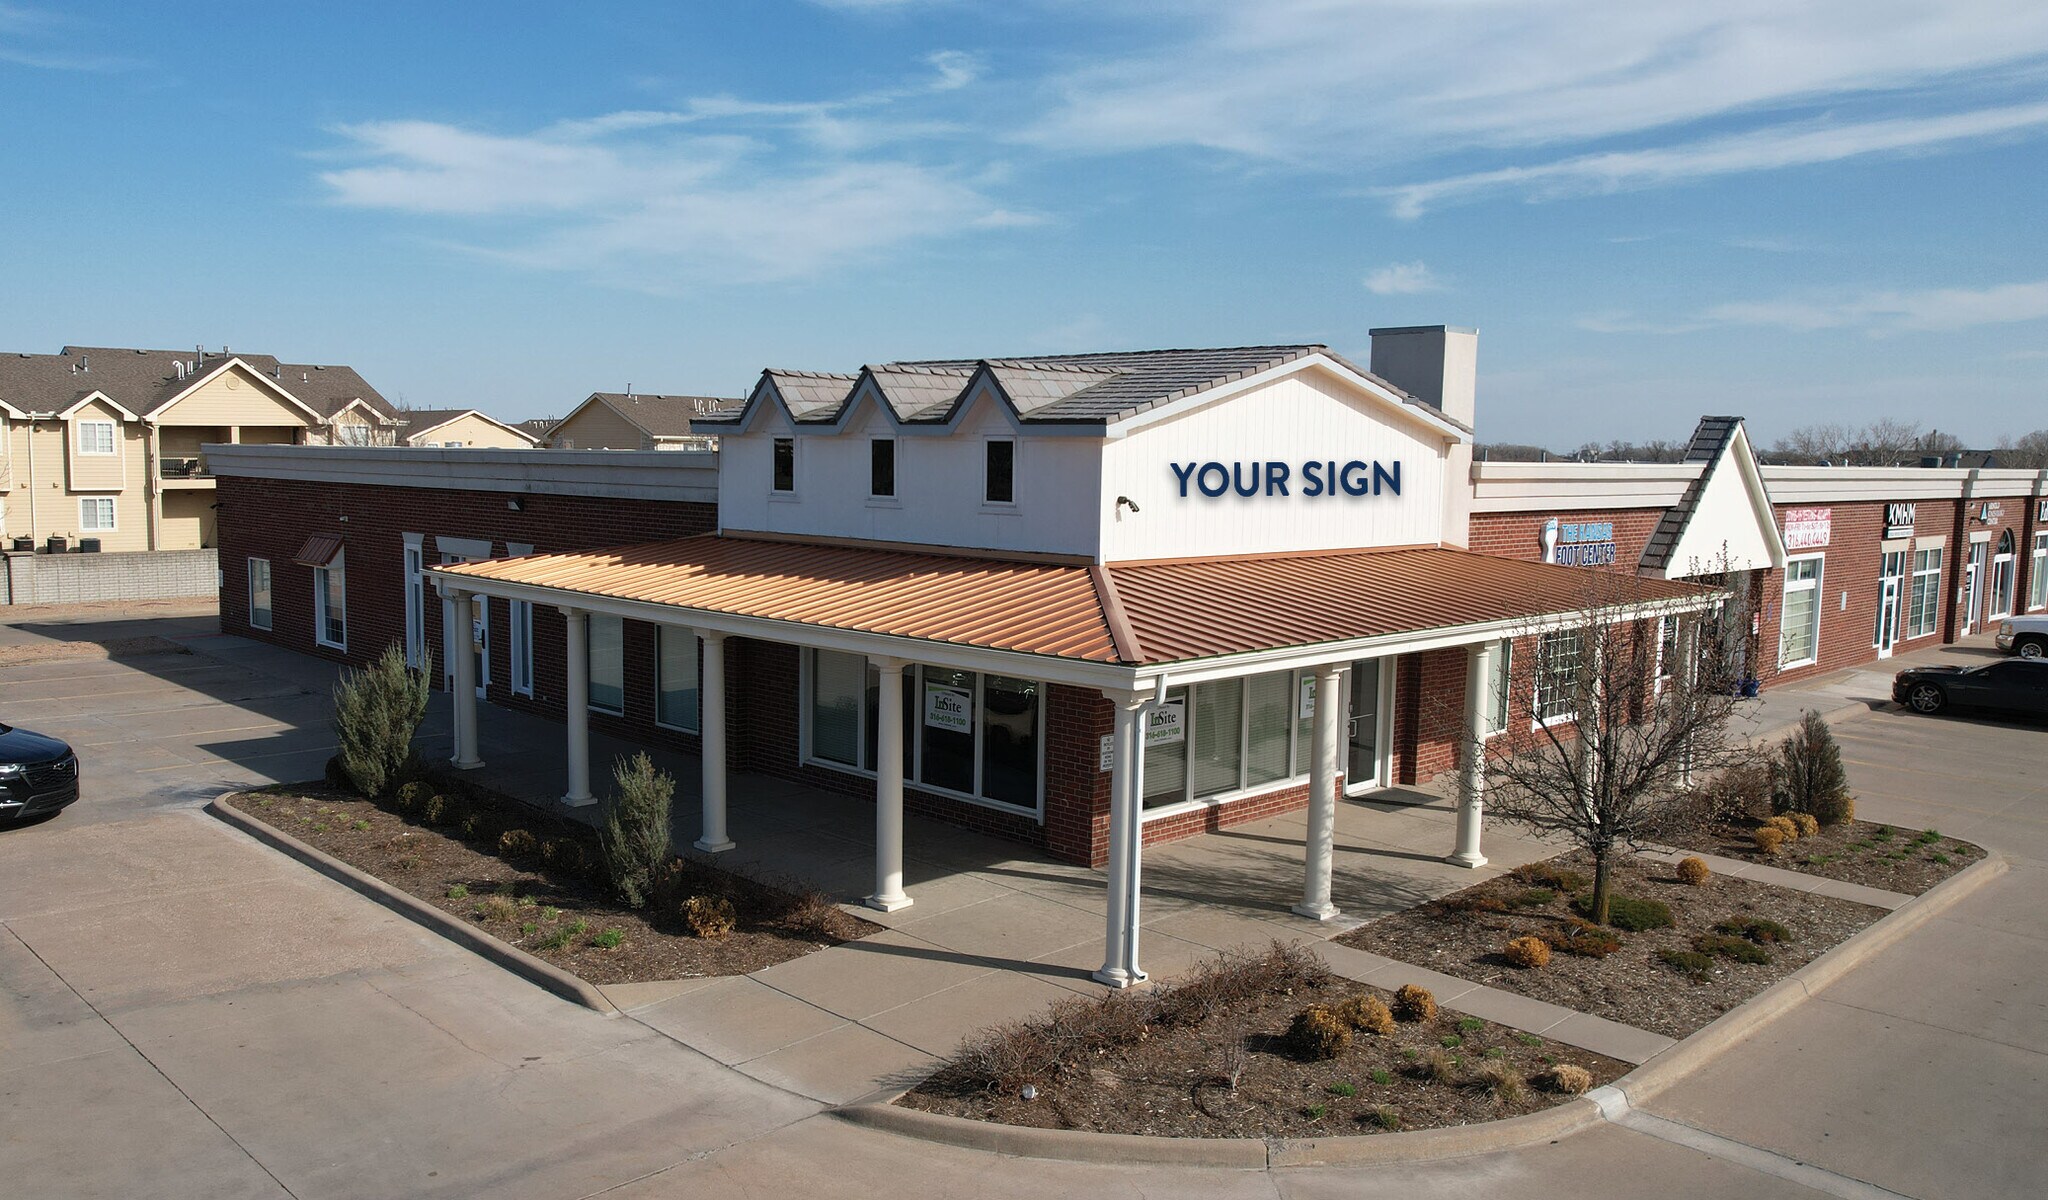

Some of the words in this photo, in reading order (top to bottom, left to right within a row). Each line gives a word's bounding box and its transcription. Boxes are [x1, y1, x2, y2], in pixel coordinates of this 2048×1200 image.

[1170, 461, 1290, 498] YOUR
[1302, 460, 1401, 497] SIGN
[1562, 524, 1578, 543] THE
[1579, 522, 1613, 541] KANSAS
[1556, 544, 1580, 567] FOOT
[1582, 542, 1616, 566] CENTER
[935, 695, 962, 713] InSite
[1150, 711, 1177, 727] InSite
